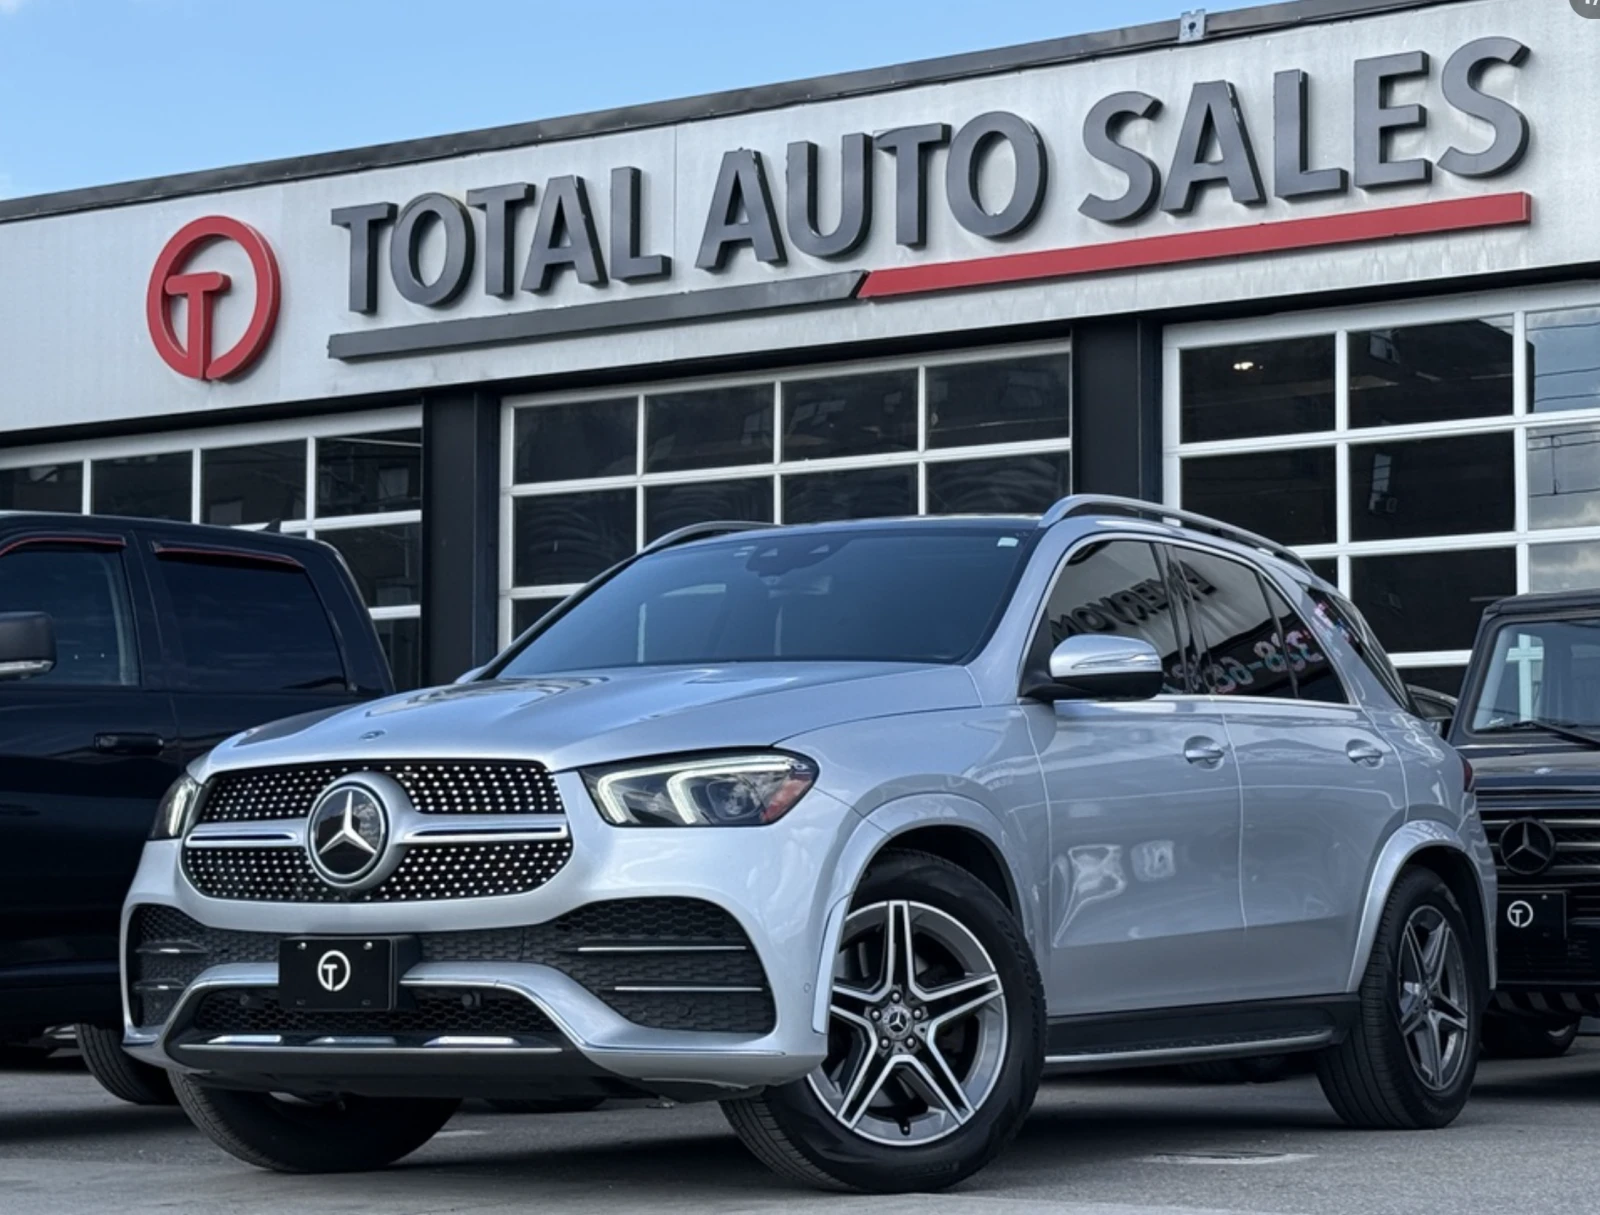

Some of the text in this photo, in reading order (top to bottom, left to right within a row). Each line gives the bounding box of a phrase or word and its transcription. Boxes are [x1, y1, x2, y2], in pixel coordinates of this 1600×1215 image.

[331, 36, 1531, 315] TOTAL AUTO SALES
